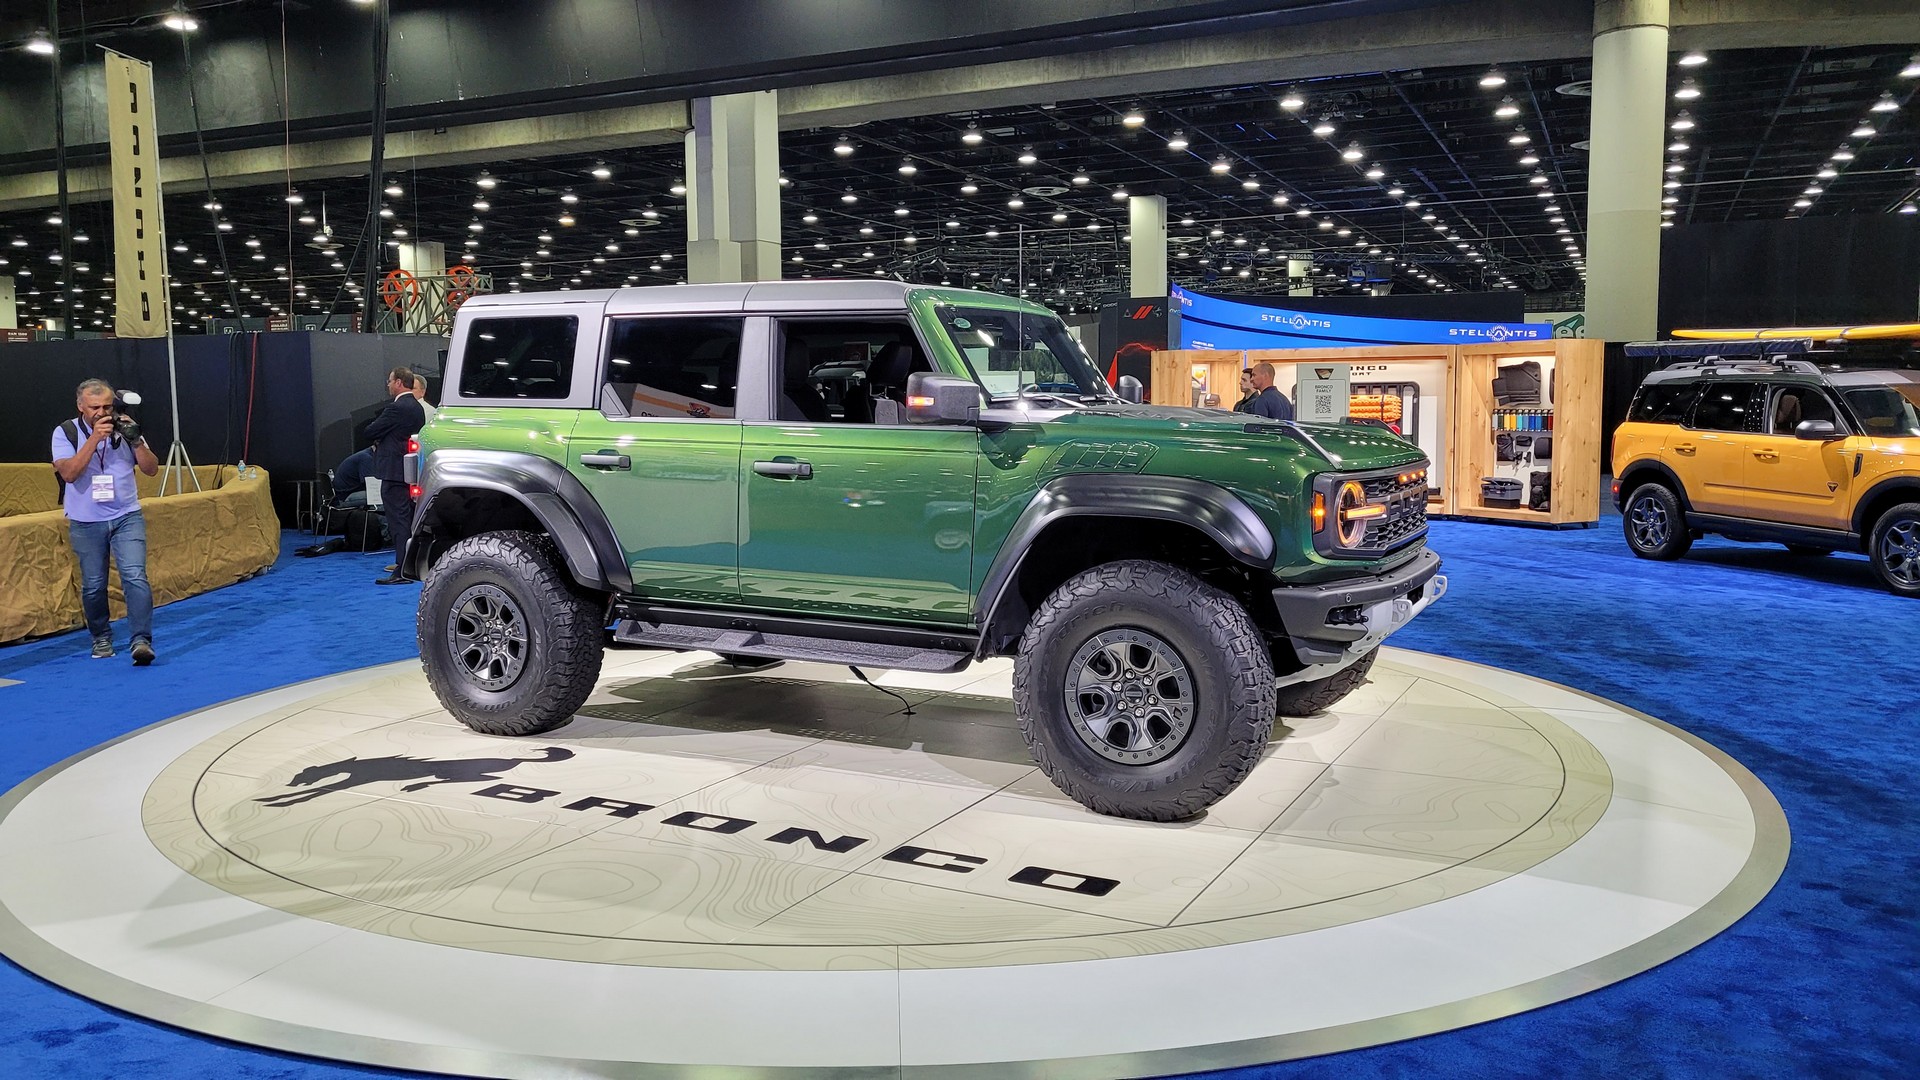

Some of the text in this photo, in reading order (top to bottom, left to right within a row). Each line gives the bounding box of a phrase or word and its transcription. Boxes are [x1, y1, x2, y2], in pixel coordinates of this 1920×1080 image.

[1261, 313, 1331, 329] STELLANTIS
[1449, 328, 1538, 339] STELLANTIS
[468, 781, 1122, 898] BRONCO
